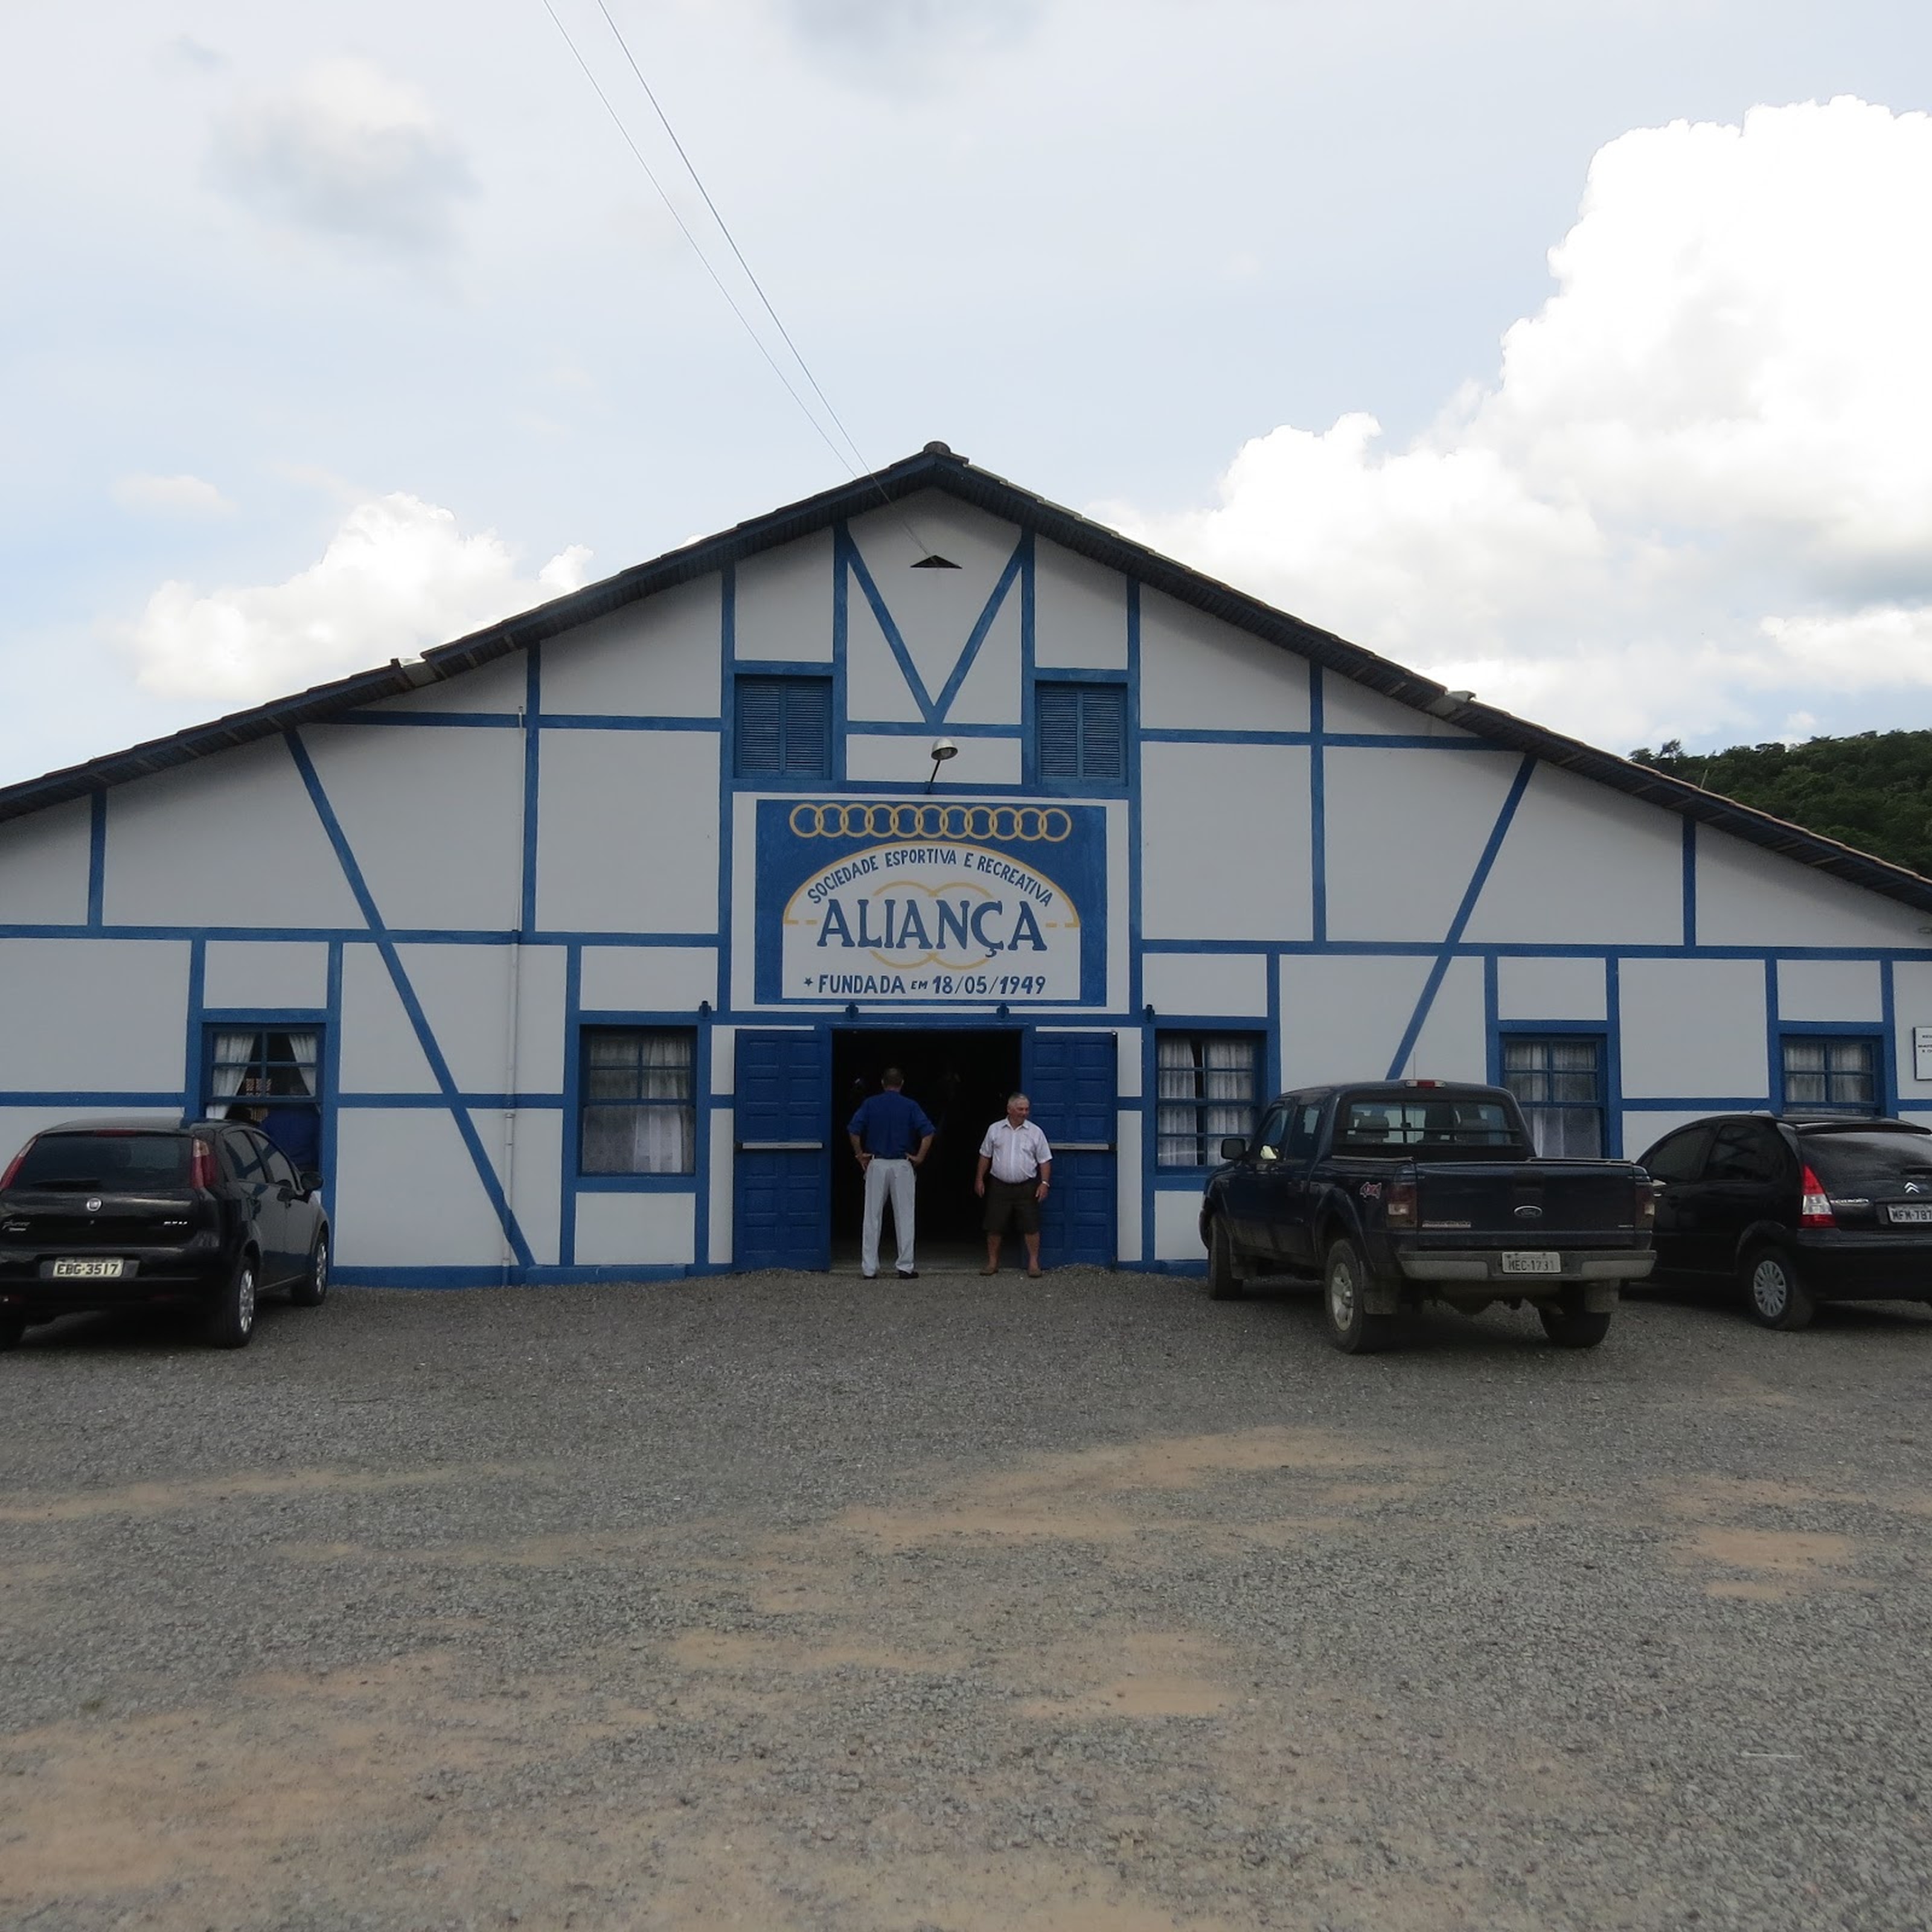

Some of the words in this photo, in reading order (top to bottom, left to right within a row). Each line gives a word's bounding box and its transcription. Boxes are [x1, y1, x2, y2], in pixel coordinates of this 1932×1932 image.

[808, 855, 878, 903] SOCIEDADE
[884, 848, 957, 868] ESPORTIVA
[964, 852, 974, 868] E
[977, 855, 1053, 907] RECREATIVA
[817, 898, 1047, 958] ALIANÇA
[818, 974, 906, 994] FUNDADA
[911, 980, 927, 990] EM
[932, 975, 1046, 995] 18/05/1949
